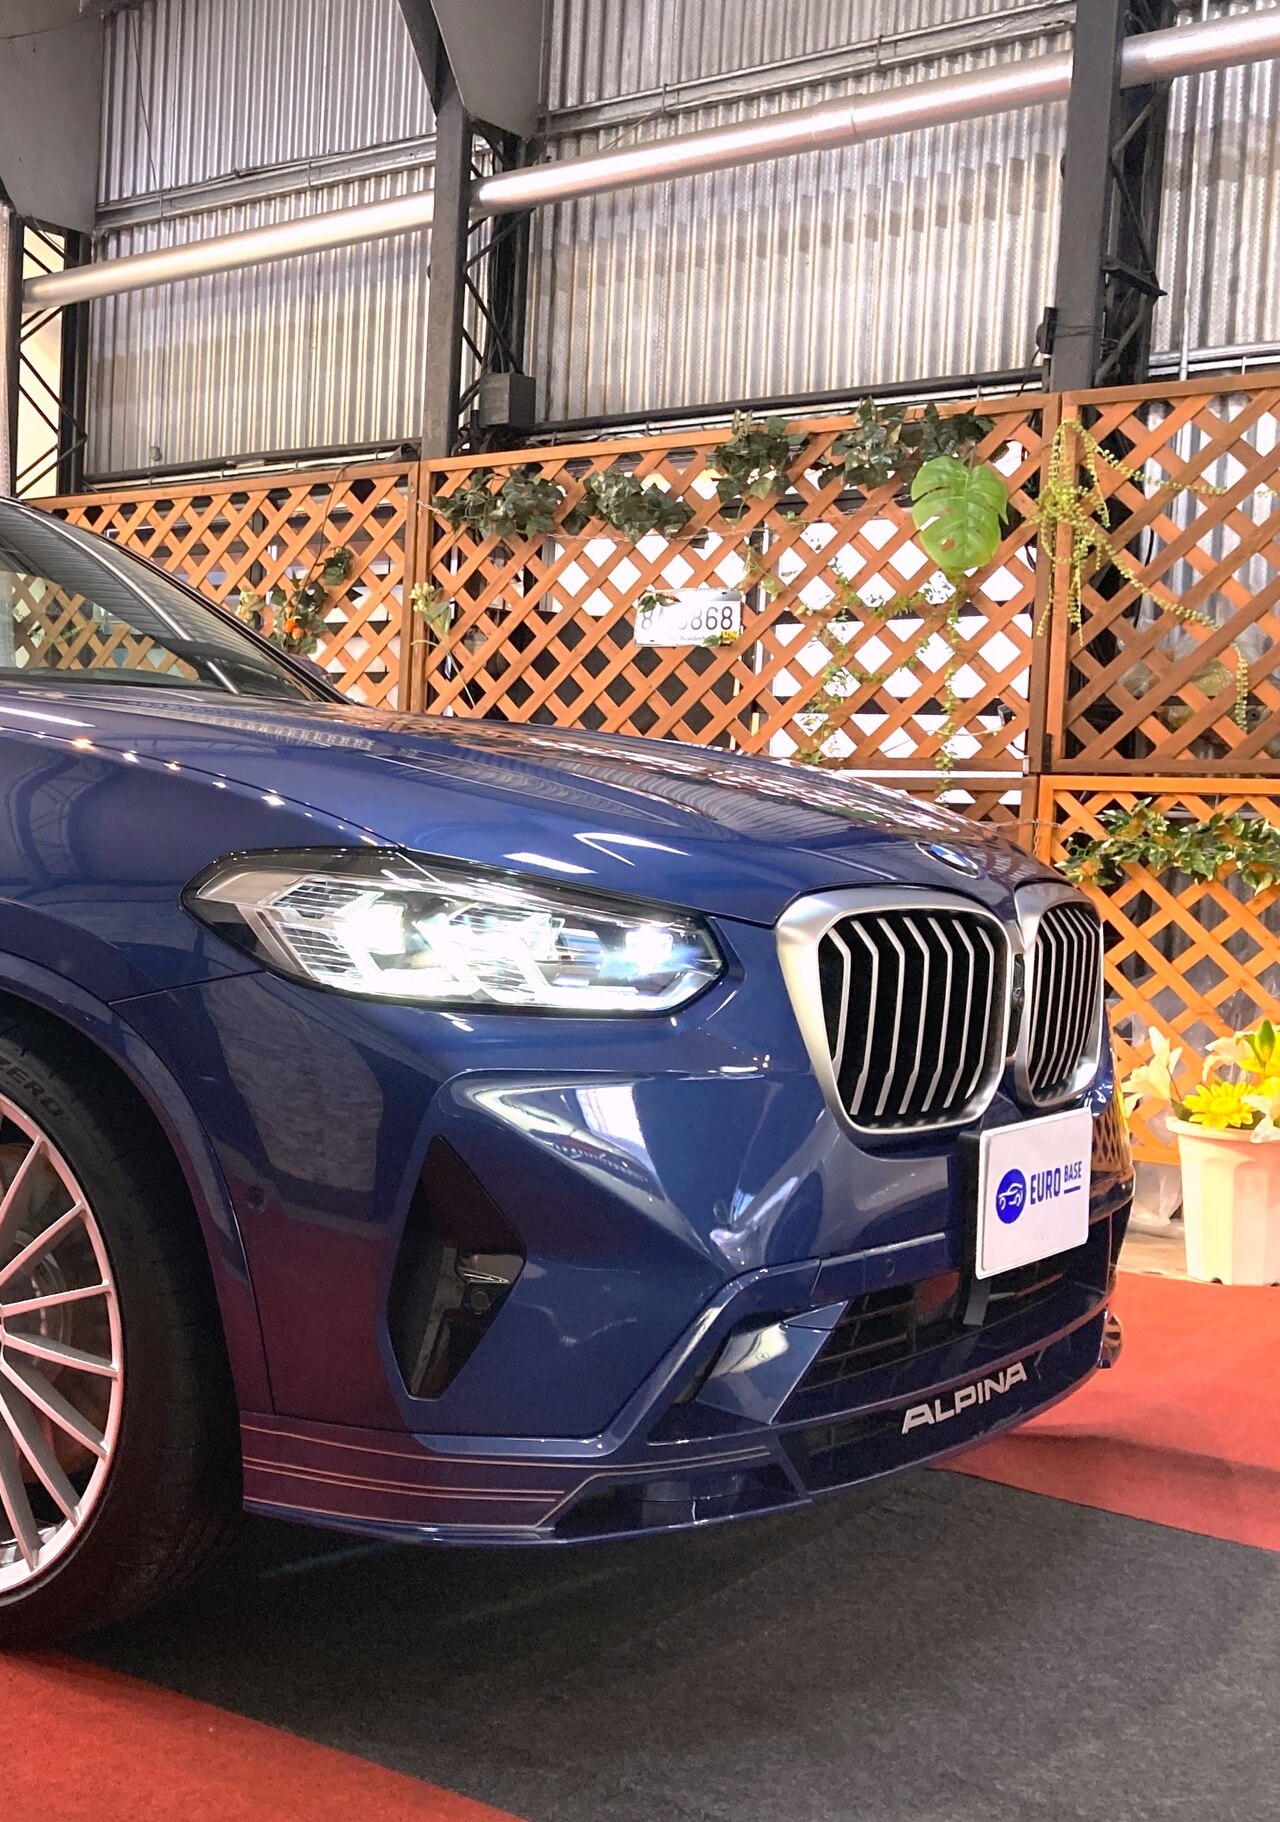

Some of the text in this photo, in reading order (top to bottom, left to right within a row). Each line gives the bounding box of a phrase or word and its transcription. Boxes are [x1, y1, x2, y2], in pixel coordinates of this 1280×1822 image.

[1030, 1161, 1083, 1205] EURO BASE
[901, 1362, 1028, 1435] ALPINA
